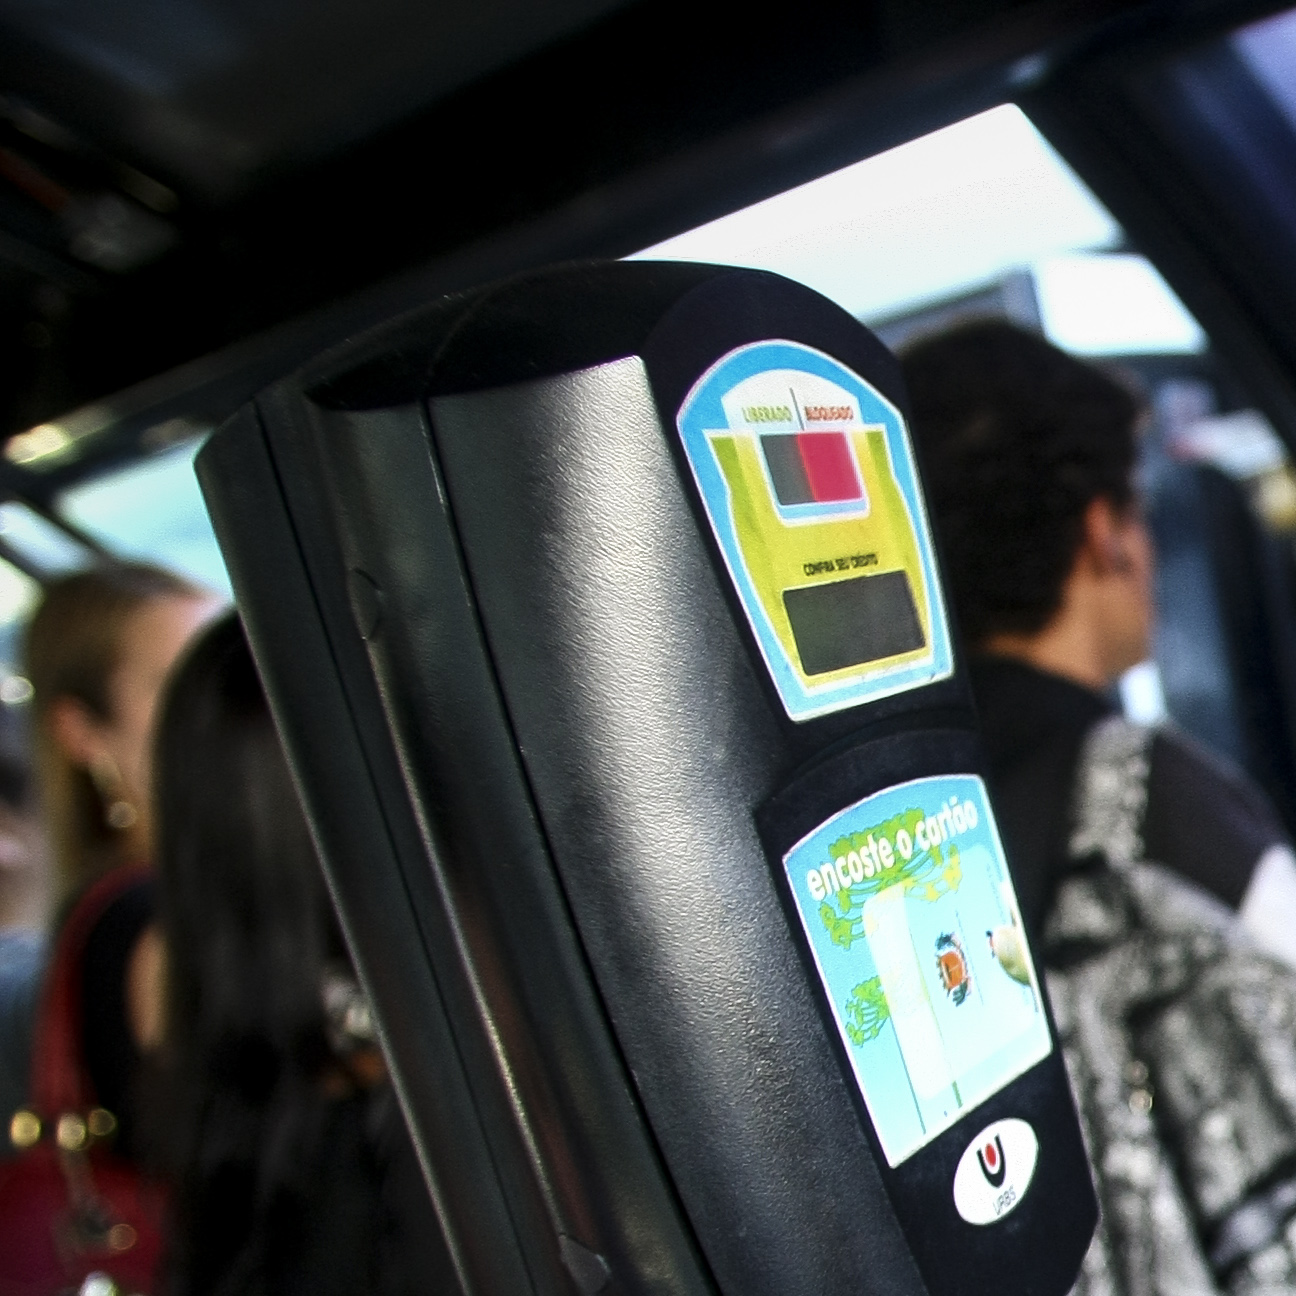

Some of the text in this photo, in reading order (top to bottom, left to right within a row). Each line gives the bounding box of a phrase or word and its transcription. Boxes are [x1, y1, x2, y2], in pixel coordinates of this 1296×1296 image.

[741, 406, 793, 423] LIBERADO
[804, 405, 854, 421] BLOQUEADO
[803, 560, 835, 577] CONFIRA
[835, 557, 850, 571] SEU
[806, 795, 979, 901] encoste o cartão
